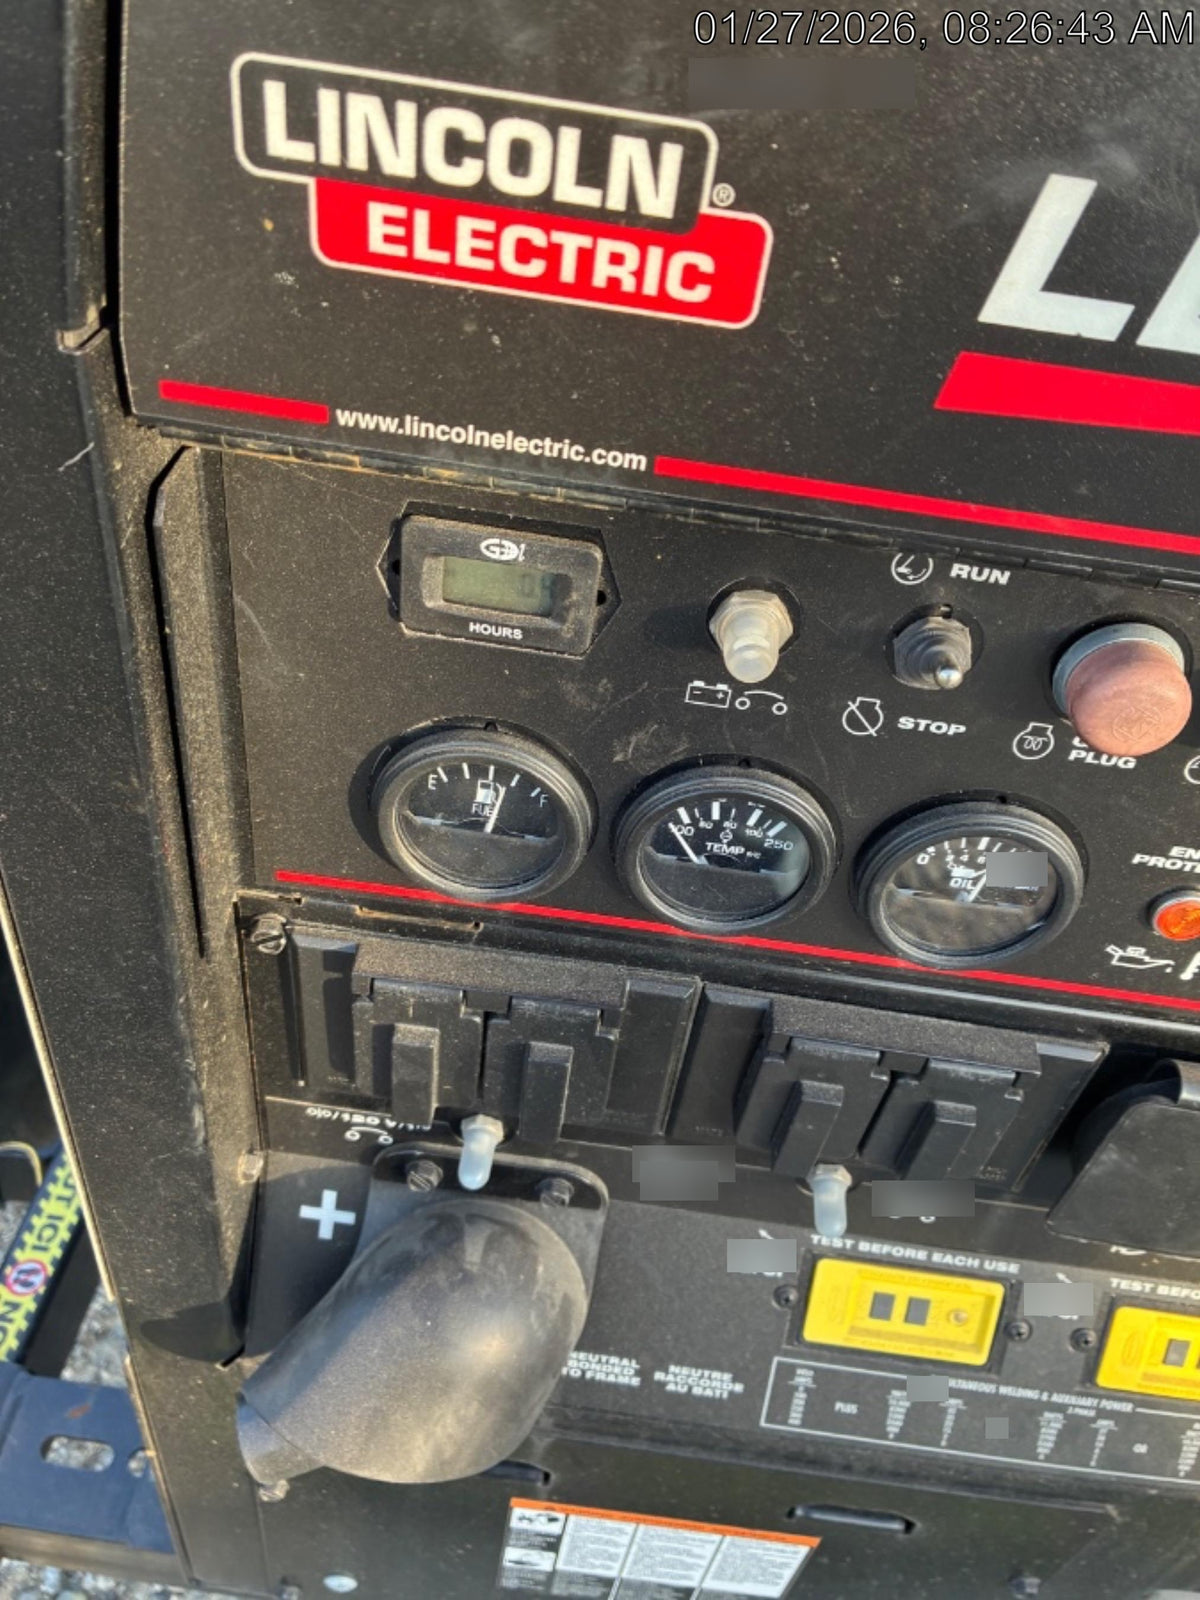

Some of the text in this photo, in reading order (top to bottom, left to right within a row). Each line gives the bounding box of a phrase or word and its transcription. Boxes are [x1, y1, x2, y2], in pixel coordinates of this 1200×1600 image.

[262, 79, 684, 220] LINCOLN
[367, 200, 716, 303] ELECTRIC
[977, 173, 1200, 355] L
[335, 408, 648, 472] www.lincolnelectric.com
[949, 563, 1011, 586] RUN
[469, 621, 523, 640] HOURS
[897, 716, 967, 735] STOP
[1068, 750, 1137, 769] PLUG
[428, 774, 438, 790] E
[540, 794, 549, 807] F
[472, 803, 497, 818] FUE
[706, 842, 745, 855] TEMP
[764, 838, 793, 850] 250
[950, 877, 977, 890] OIL
[811, 1234, 1021, 1274] TEST BEFORE EACH USE
[1110, 1278, 1154, 1293] TEST
[585, 1370, 641, 1387] FRAME
[653, 1370, 745, 1393] RACCORDE
[668, 1364, 733, 1381] NEUTRE
[665, 1382, 689, 1394] AU
